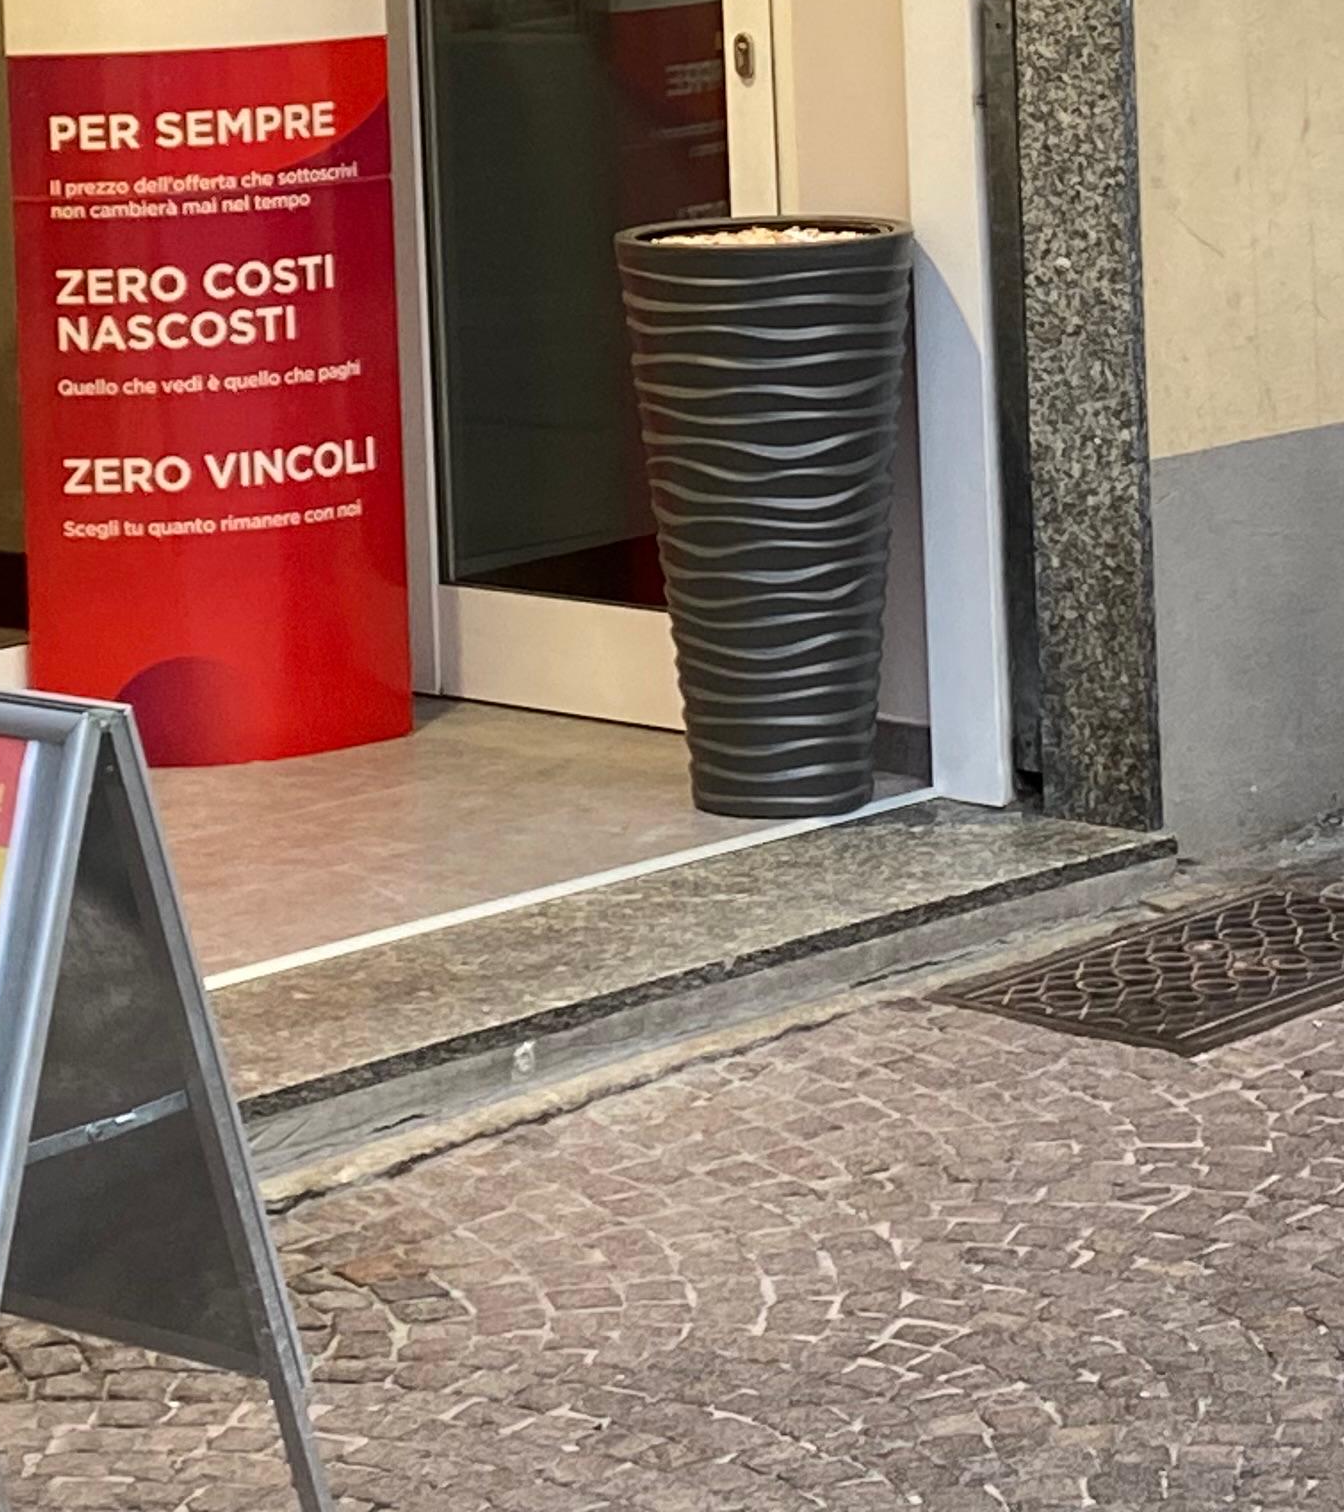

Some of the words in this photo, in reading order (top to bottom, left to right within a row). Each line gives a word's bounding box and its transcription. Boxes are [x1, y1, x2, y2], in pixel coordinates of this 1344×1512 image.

[49, 113, 140, 152] PER
[155, 100, 336, 149] SEMPRE
[49, 178, 61, 196] Il
[64, 180, 130, 199] prezzo
[133, 174, 238, 194] dell'offerta
[240, 170, 274, 189] che
[277, 160, 358, 186] sottoscrivi
[50, 204, 86, 219] non
[89, 198, 178, 219] cambierà
[182, 195, 218, 215] mai
[221, 193, 250, 213] nel
[253, 192, 311, 212] tempo
[55, 265, 188, 306] ZERO
[203, 253, 335, 300] COSTI
[57, 305, 297, 353] NASCOSTI
[57, 378, 118, 397] Quello
[122, 375, 156, 395] che
[161, 372, 203, 393] vedi
[207, 372, 219, 392] è
[224, 368, 281, 395] quello
[284, 365, 315, 386] che
[318, 359, 361, 385] paghi
[63, 455, 191, 494] ZERO
[205, 436, 376, 490] VINCOLI
[63, 519, 120, 541] Scegli
[124, 520, 145, 537] tu
[148, 516, 216, 541] quanto
[220, 510, 300, 532] rimanere
[304, 506, 334, 525] con
[337, 498, 363, 519] noi
